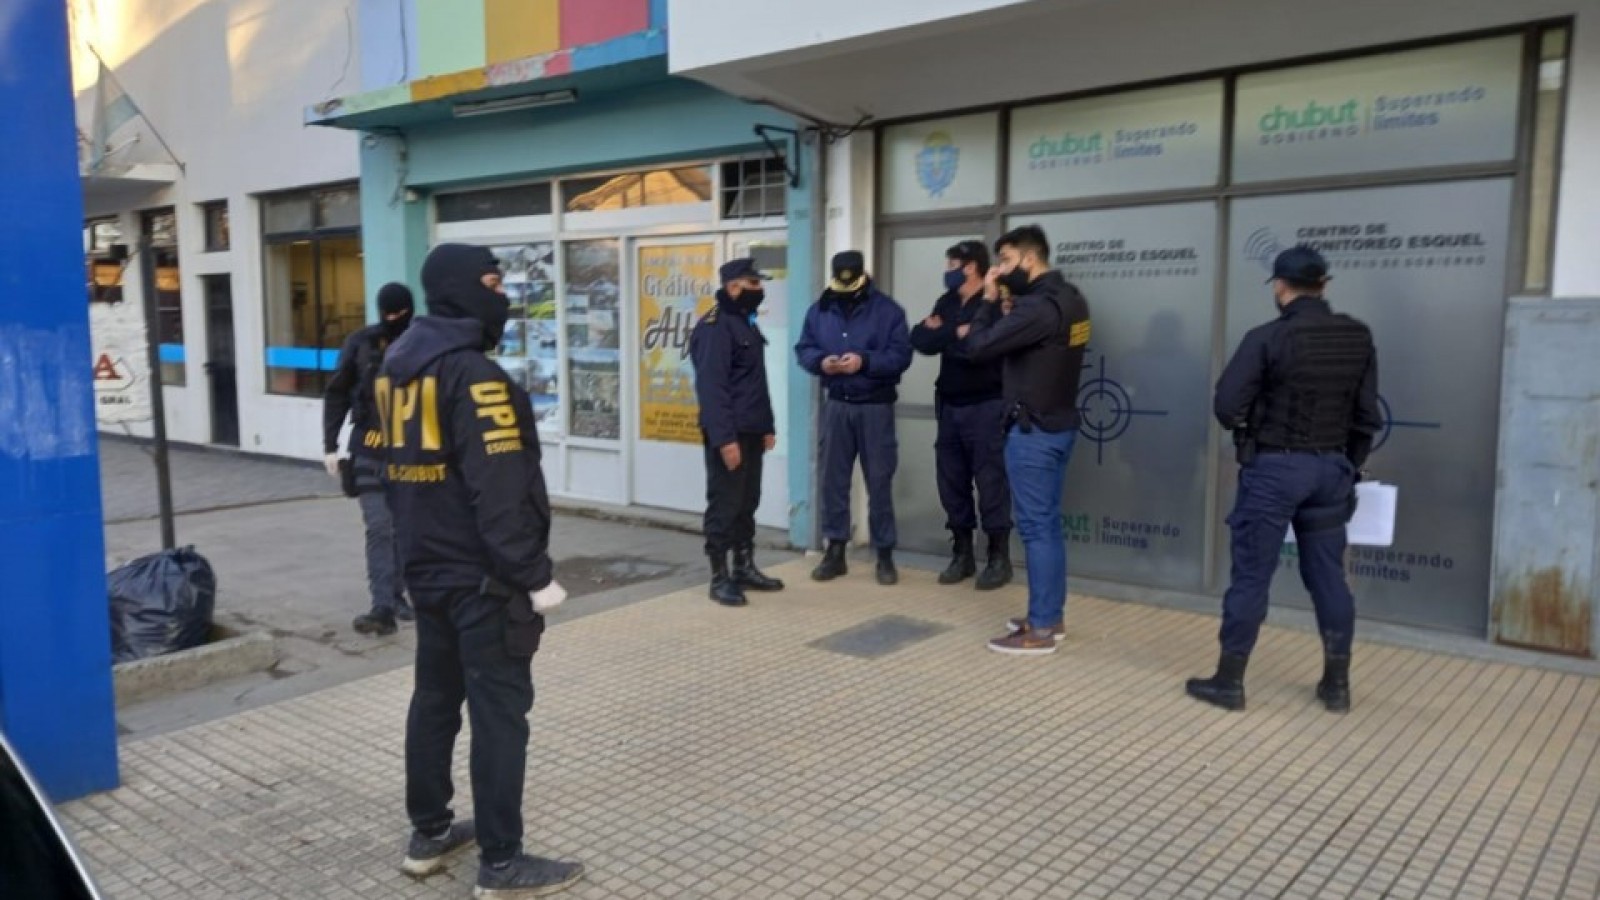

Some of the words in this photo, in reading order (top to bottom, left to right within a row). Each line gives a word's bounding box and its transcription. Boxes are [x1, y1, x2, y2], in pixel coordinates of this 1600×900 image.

[1374, 86, 1486, 113] Superando
[1258, 98, 1358, 133] chubut
[1114, 121, 1198, 144] Superando
[1259, 124, 1359, 146] GOBIERNO
[1028, 129, 1103, 160] chubut
[1028, 153, 1103, 171] GOBIERNO
[1296, 224, 1361, 239] CENTRO
[1365, 222, 1387, 235] DE
[1407, 232, 1487, 250] ESQUEL
[1055, 250, 1137, 265] MONITOREO
[1139, 246, 1199, 261] ESQUEL
[1056, 240, 1106, 252] CENTRO
[1108, 238, 1125, 250] DE
[374, 376, 441, 451] DPI
[469, 381, 521, 443] DPI
[1101, 515, 1181, 539] Superando
